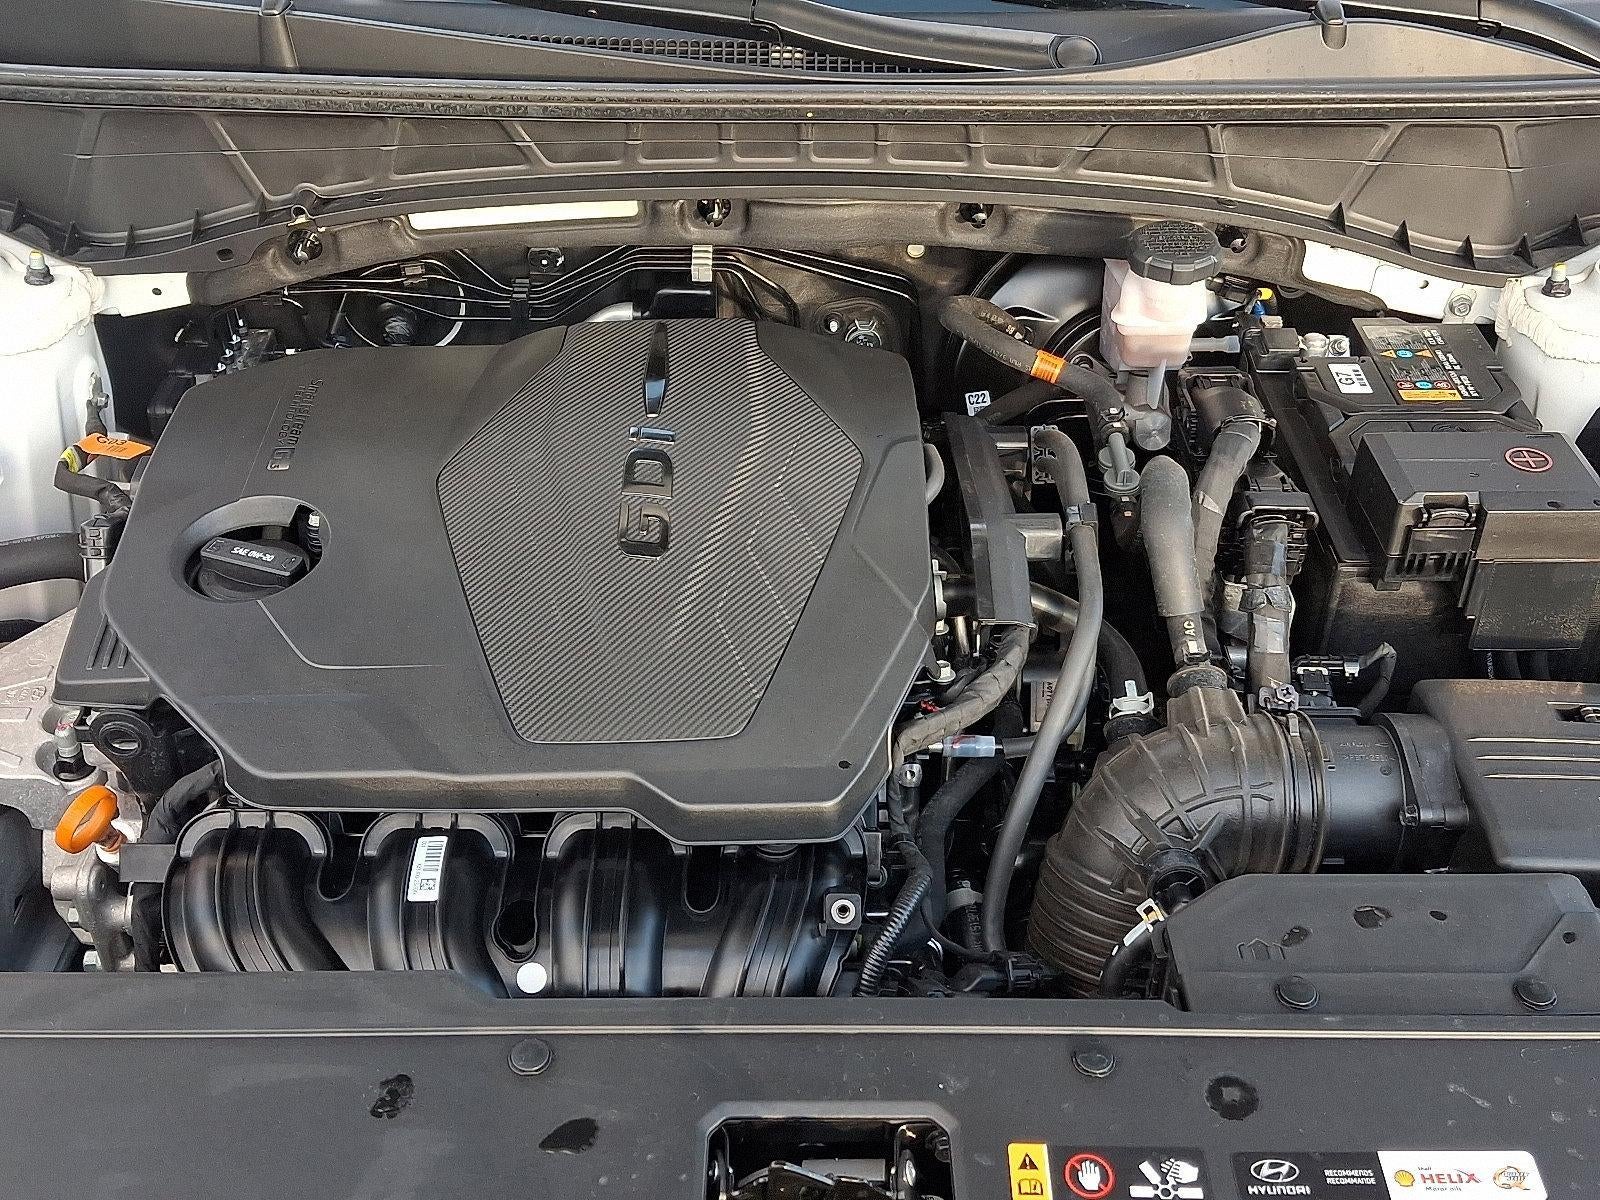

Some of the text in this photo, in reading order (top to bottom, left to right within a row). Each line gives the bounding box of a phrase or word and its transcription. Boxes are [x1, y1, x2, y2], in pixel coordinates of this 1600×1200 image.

[1334, 371, 1355, 386] G7
[968, 392, 987, 405] C22
[230, 546, 250, 556] SAE
[1183, 619, 1196, 637] AC
[1420, 1173, 1481, 1184] HELIX
[1247, 1185, 1312, 1196] HYUNDAI
